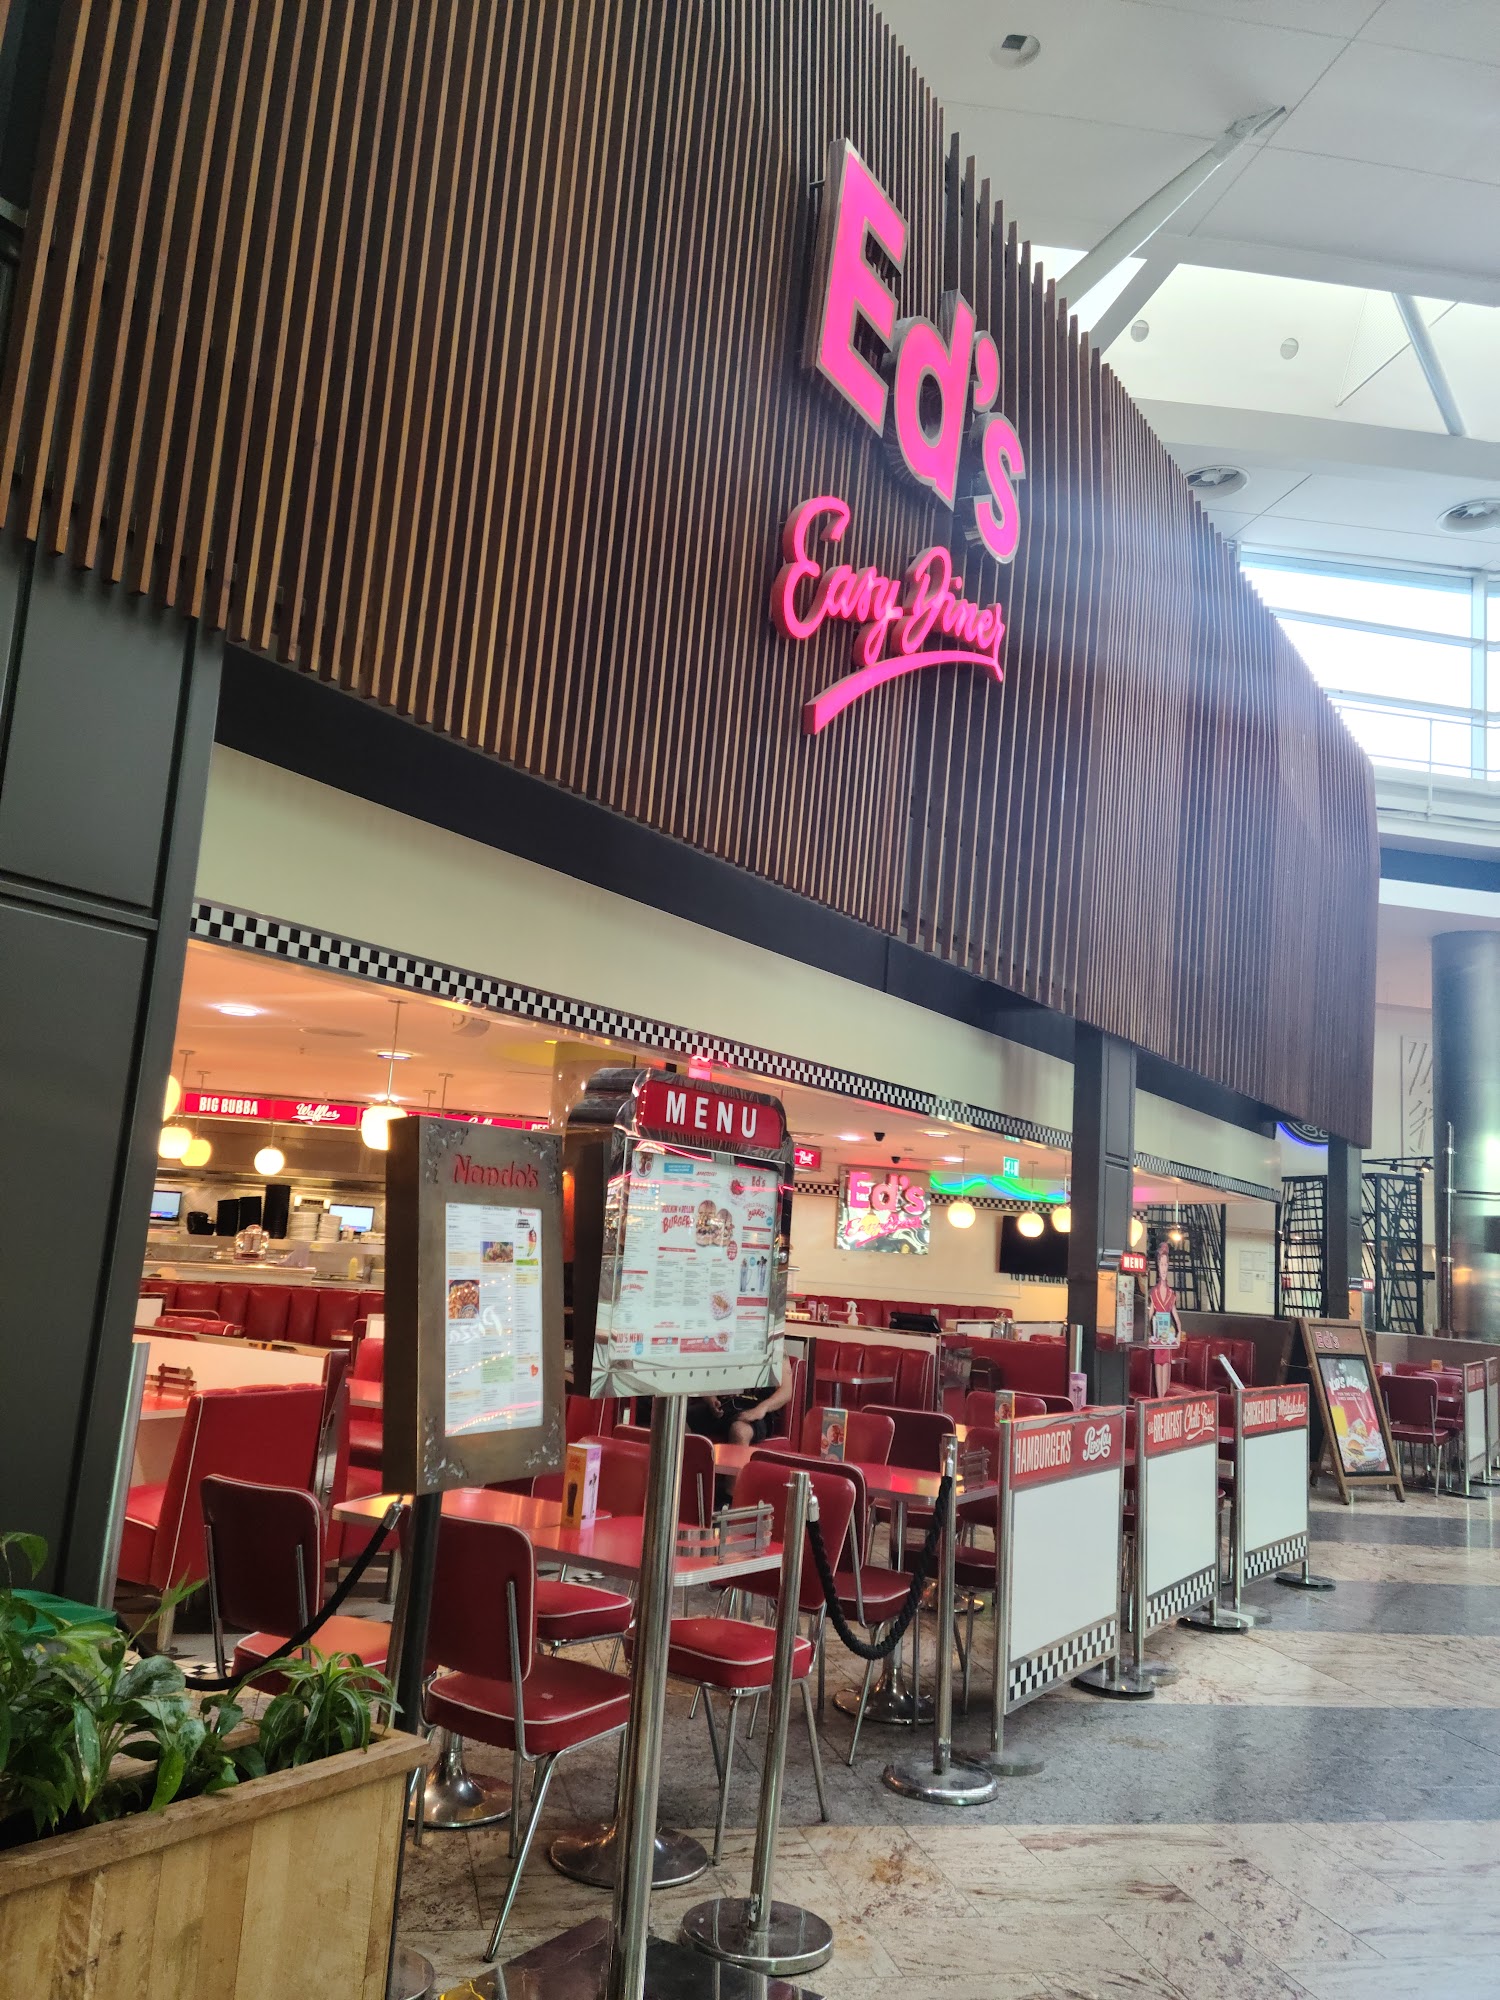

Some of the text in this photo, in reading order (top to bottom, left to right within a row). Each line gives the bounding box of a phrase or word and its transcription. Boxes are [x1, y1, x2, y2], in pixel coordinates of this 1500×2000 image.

[808, 137, 1026, 564] Ed's
[774, 496, 1006, 667] Easy Diner
[199, 1096, 259, 1116] BIG BUBBA
[295, 1103, 341, 1122] Waffles
[665, 1090, 757, 1139] MENU
[453, 1153, 539, 1189] Nando's
[848, 1171, 926, 1216] Ed's
[1123, 1256, 1144, 1270] MENU
[1315, 1331, 1340, 1349] Ed's
[1329, 1376, 1368, 1395] KID'S MENU
[1153, 1410, 1183, 1443] BREAKFAST
[1184, 1401, 1215, 1435] Chilli Fries
[1243, 1399, 1277, 1427] CHICKEN CLUB
[1014, 1429, 1072, 1475] HAMBURGERS
